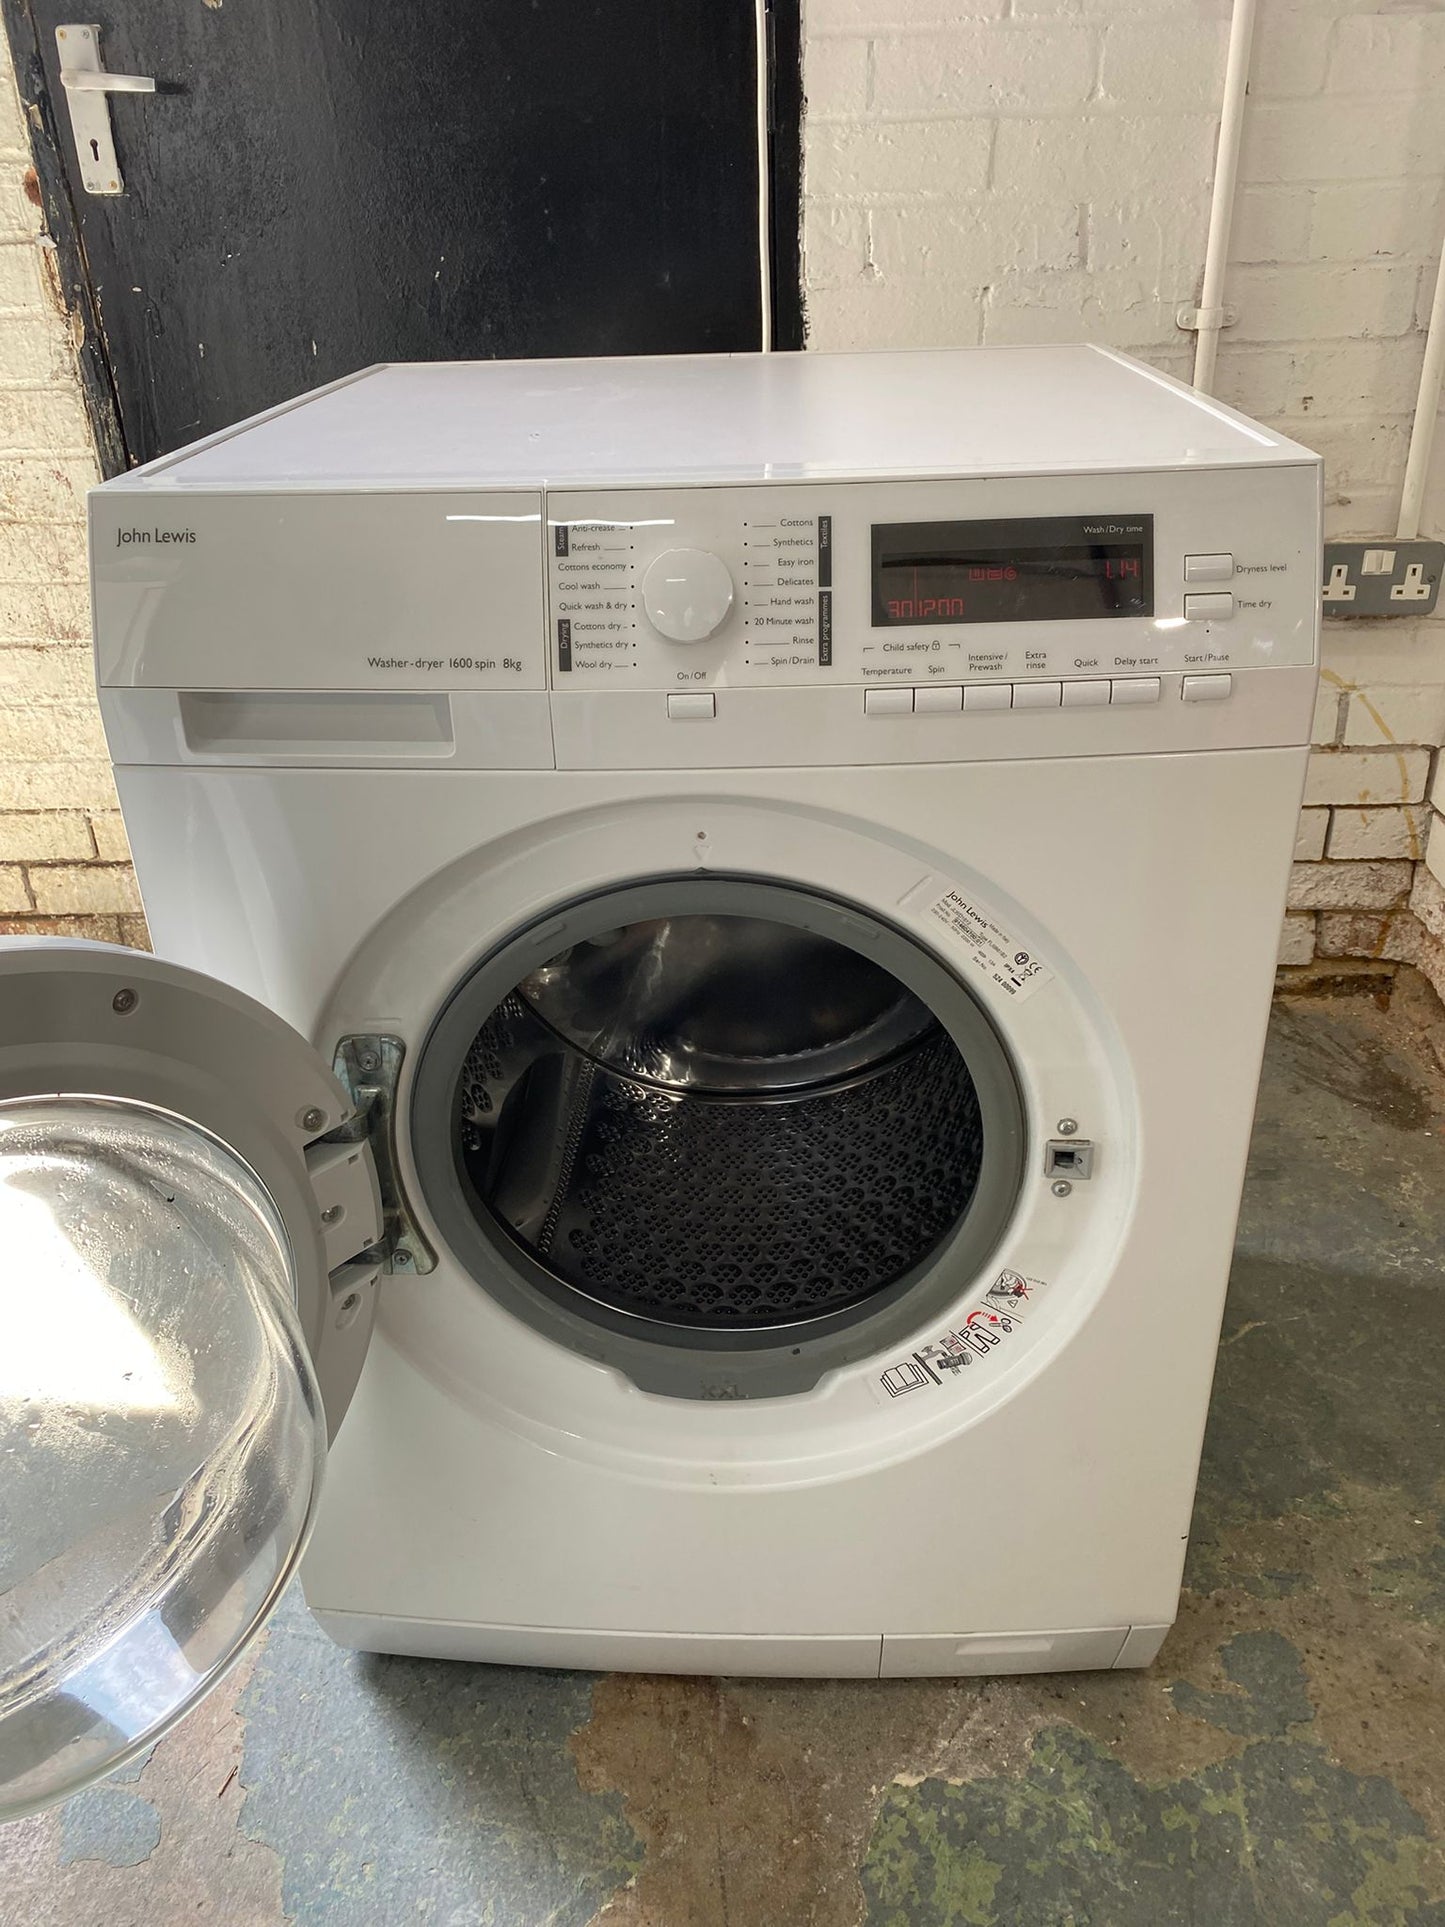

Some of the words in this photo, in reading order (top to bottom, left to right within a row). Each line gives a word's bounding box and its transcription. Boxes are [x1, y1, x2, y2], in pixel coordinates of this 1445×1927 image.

[780, 518, 813, 527] Cottons
[571, 525, 615, 533] Anti-crease
[820, 520, 829, 548] Textiles
[1126, 525, 1143, 533] time
[116, 527, 151, 547] John
[155, 527, 197, 543] Lewis
[571, 543, 601, 552] Refresh
[772, 537, 814, 548] Synthetics
[557, 562, 590, 571] Cottons
[591, 563, 627, 572] economy
[777, 557, 796, 567] Easy
[1236, 565, 1268, 574] Dryness
[1270, 564, 1287, 572] level
[558, 582, 579, 590] Cool
[580, 582, 601, 590] wash
[777, 577, 815, 586] Delicates
[559, 601, 583, 611] Quick
[585, 602, 604, 610] wash
[606, 602, 612, 610] &
[614, 601, 628, 611] dry
[770, 598, 792, 606] Hand
[794, 597, 815, 605] wash
[1238, 600, 1257, 608] Time
[1259, 599, 1273, 609] dry
[754, 617, 765, 626] 20
[766, 617, 793, 626] Minute
[795, 617, 815, 625] wash
[822, 595, 831, 640] programmes
[573, 622, 606, 631] Cottons
[607, 621, 622, 631] dry
[559, 622, 570, 649] Drying
[792, 636, 815, 645] Rinse
[574, 641, 614, 651] Synthetics
[615, 640, 629, 650] dry
[882, 643, 905, 652] Child
[906, 642, 930, 653] safety
[820, 642, 830, 662] Extra
[1025, 651, 1047, 660] Extra
[770, 655, 815, 667] Spin/Drain
[1073, 657, 1099, 668] Quick
[1114, 656, 1137, 666] Delay
[1138, 656, 1159, 665] start
[1184, 654, 1230, 663] Start/Pause
[449, 657, 473, 669] 1600
[474, 658, 496, 672] spin
[502, 657, 522, 672] 8kg
[575, 660, 598, 669] Wool
[599, 660, 613, 670] dry
[969, 663, 1003, 672] Prewash
[1026, 661, 1046, 669] rinse
[676, 671, 707, 680] On/Off
[860, 667, 913, 677] Temperature
[927, 665, 946, 675] Spin
[946, 890, 967, 910] John
[966, 906, 989, 929] Lewis
